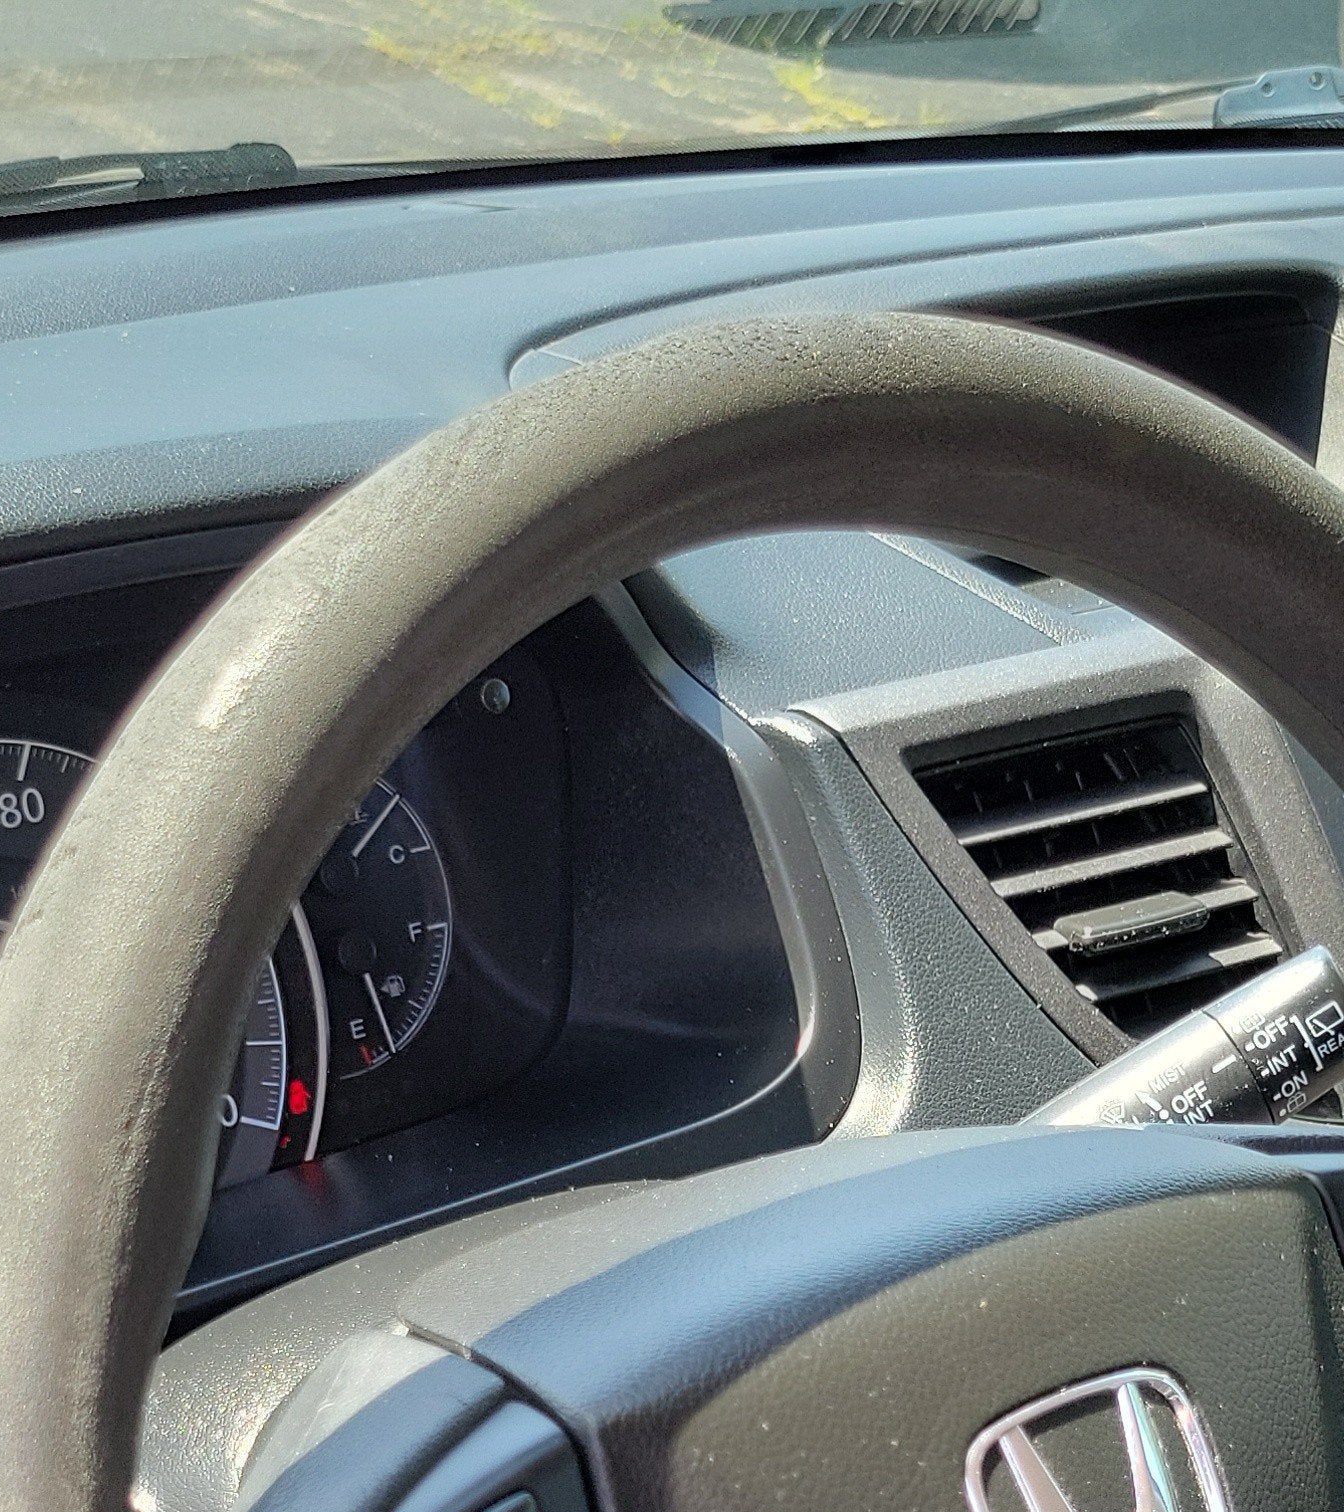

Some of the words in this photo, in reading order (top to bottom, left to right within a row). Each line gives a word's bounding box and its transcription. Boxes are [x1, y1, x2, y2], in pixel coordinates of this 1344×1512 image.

[389, 844, 406, 866] C
[408, 921, 424, 943] F
[350, 1019, 367, 1040] E
[1253, 1015, 1289, 1049] OFF
[1267, 1045, 1298, 1075] INT
[1150, 1064, 1186, 1094] MIST
[1281, 1071, 1308, 1098] ON
[1172, 1081, 1207, 1114] OFF
[1184, 1100, 1214, 1125] INT
